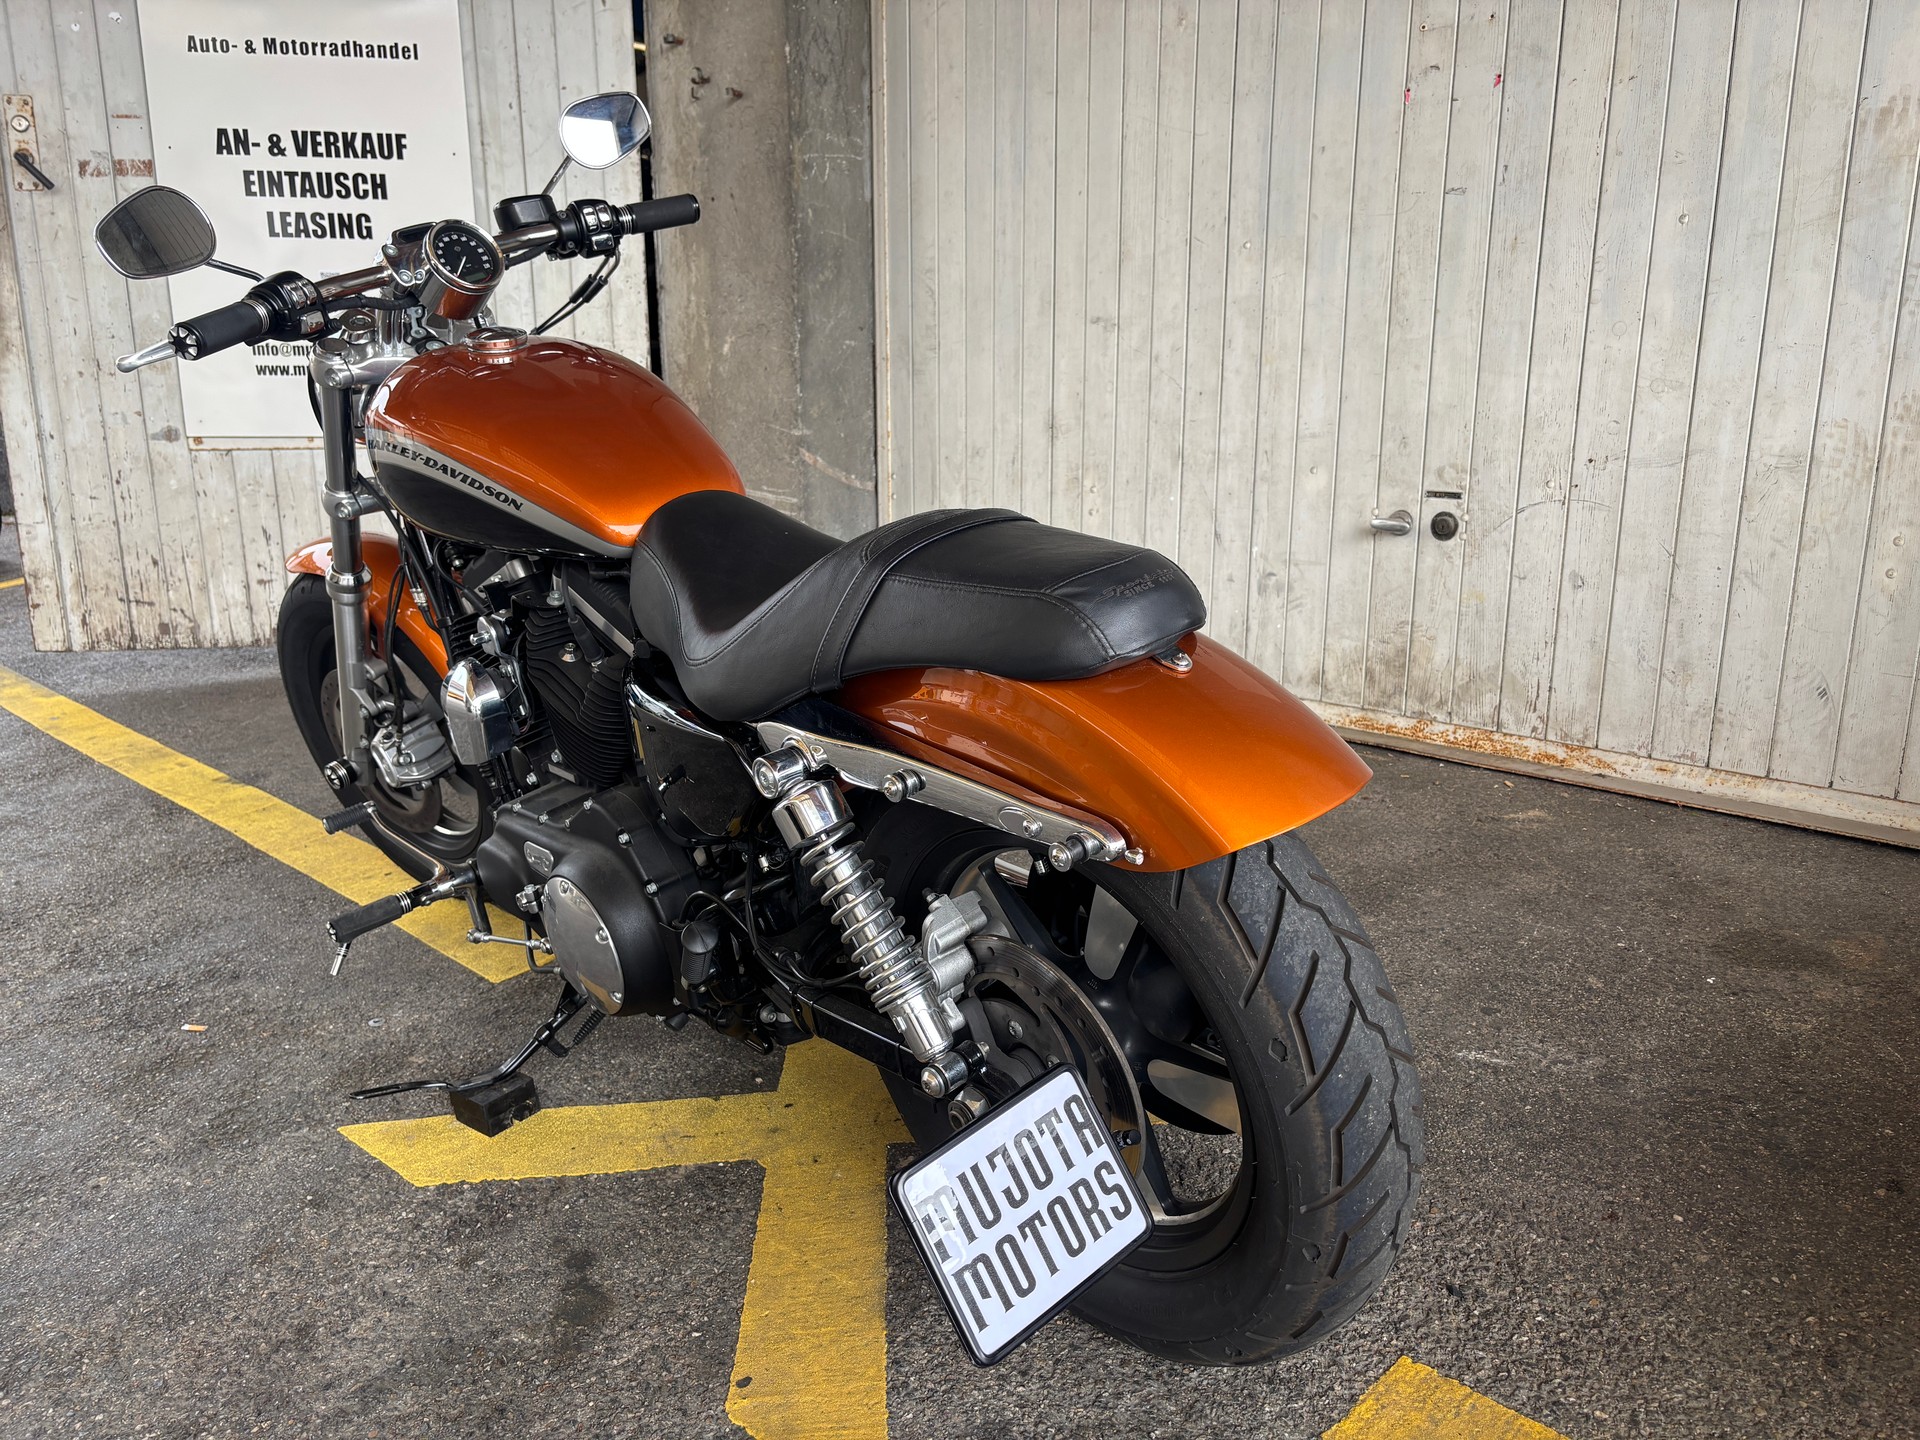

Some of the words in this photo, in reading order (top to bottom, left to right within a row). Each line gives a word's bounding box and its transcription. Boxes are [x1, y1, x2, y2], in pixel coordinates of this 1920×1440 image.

[187, 35, 238, 54] Auto-
[244, 39, 257, 55] &
[262, 37, 419, 61] Motorradhandel
[216, 128, 261, 156] AN-
[267, 133, 287, 157] &
[290, 130, 408, 161] VERKAUF
[242, 169, 389, 201] EINTAUSCH
[266, 211, 374, 240] LEASING
[255, 364, 309, 376] www.m
[914, 1093, 1105, 1265] MUJOTA
[951, 1160, 1133, 1334] MOTORS
